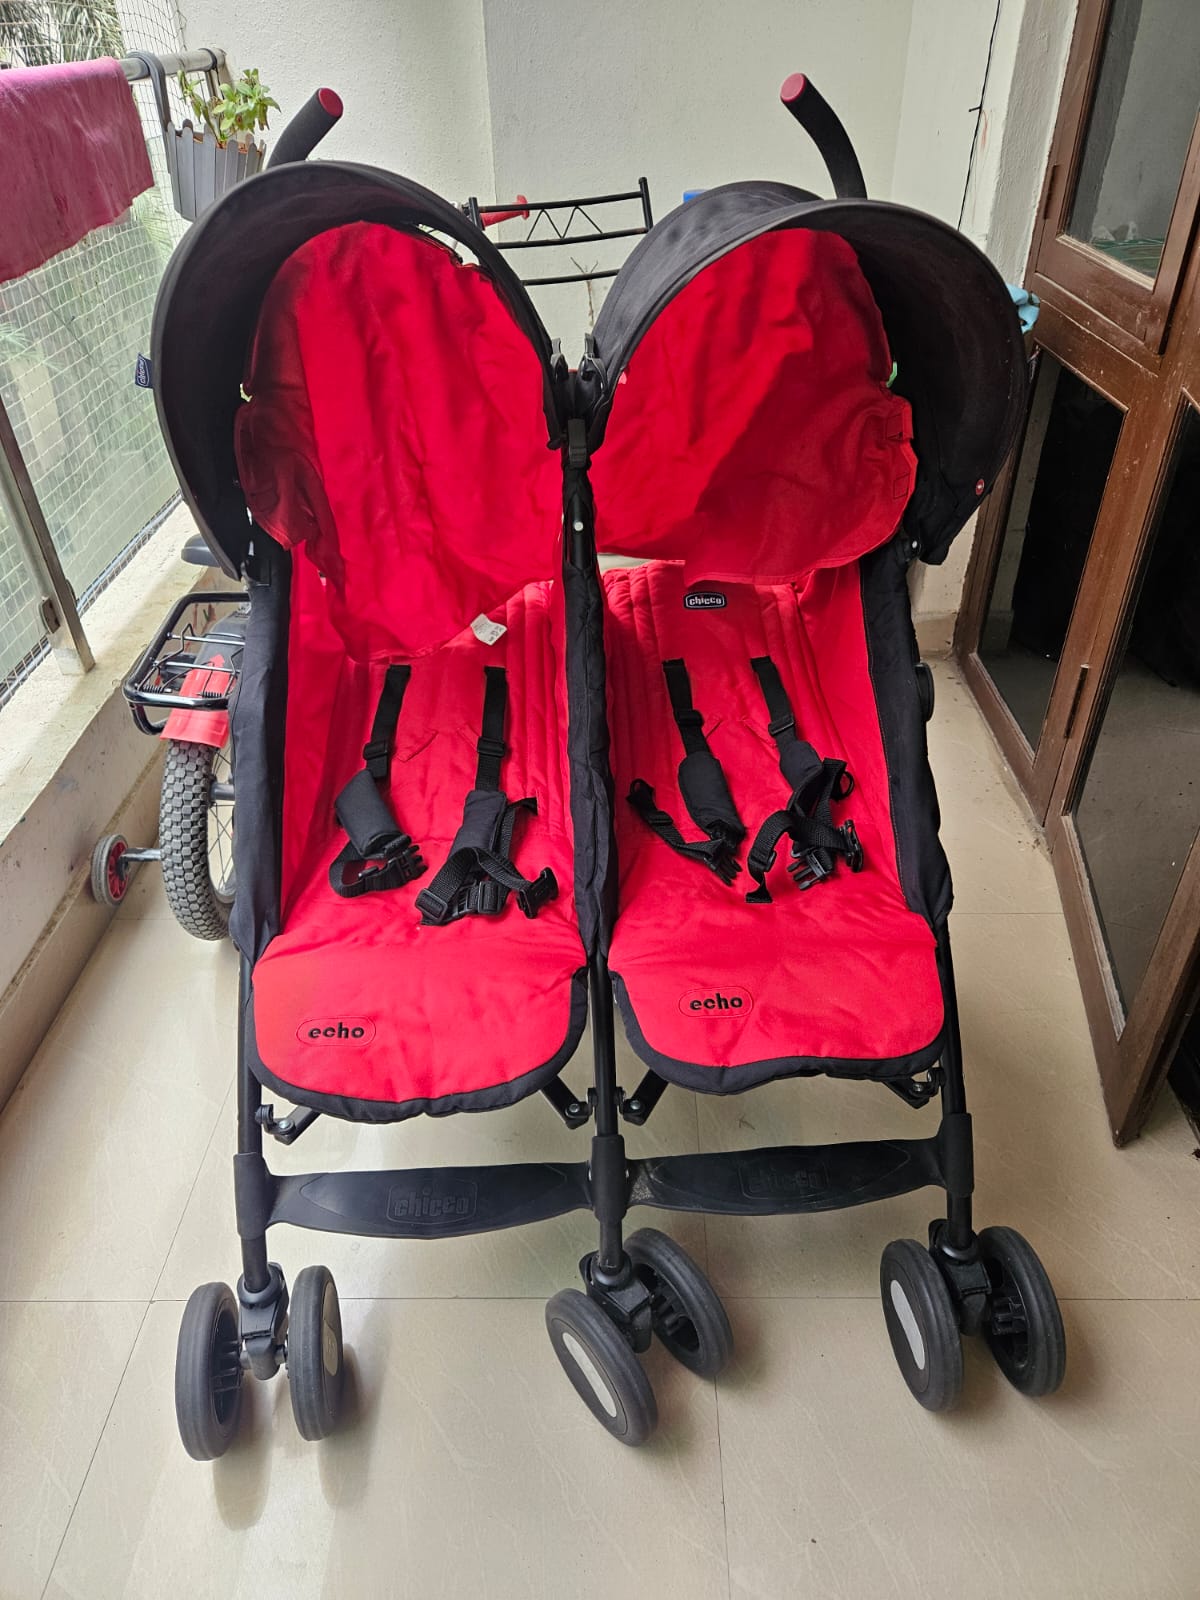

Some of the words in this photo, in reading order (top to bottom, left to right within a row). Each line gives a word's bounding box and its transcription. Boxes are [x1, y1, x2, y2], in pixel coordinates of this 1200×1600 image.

[689, 595, 722, 606] chicco
[689, 993, 743, 1011] echo
[308, 1022, 365, 1039] echo
[394, 1186, 469, 1217] chicco
